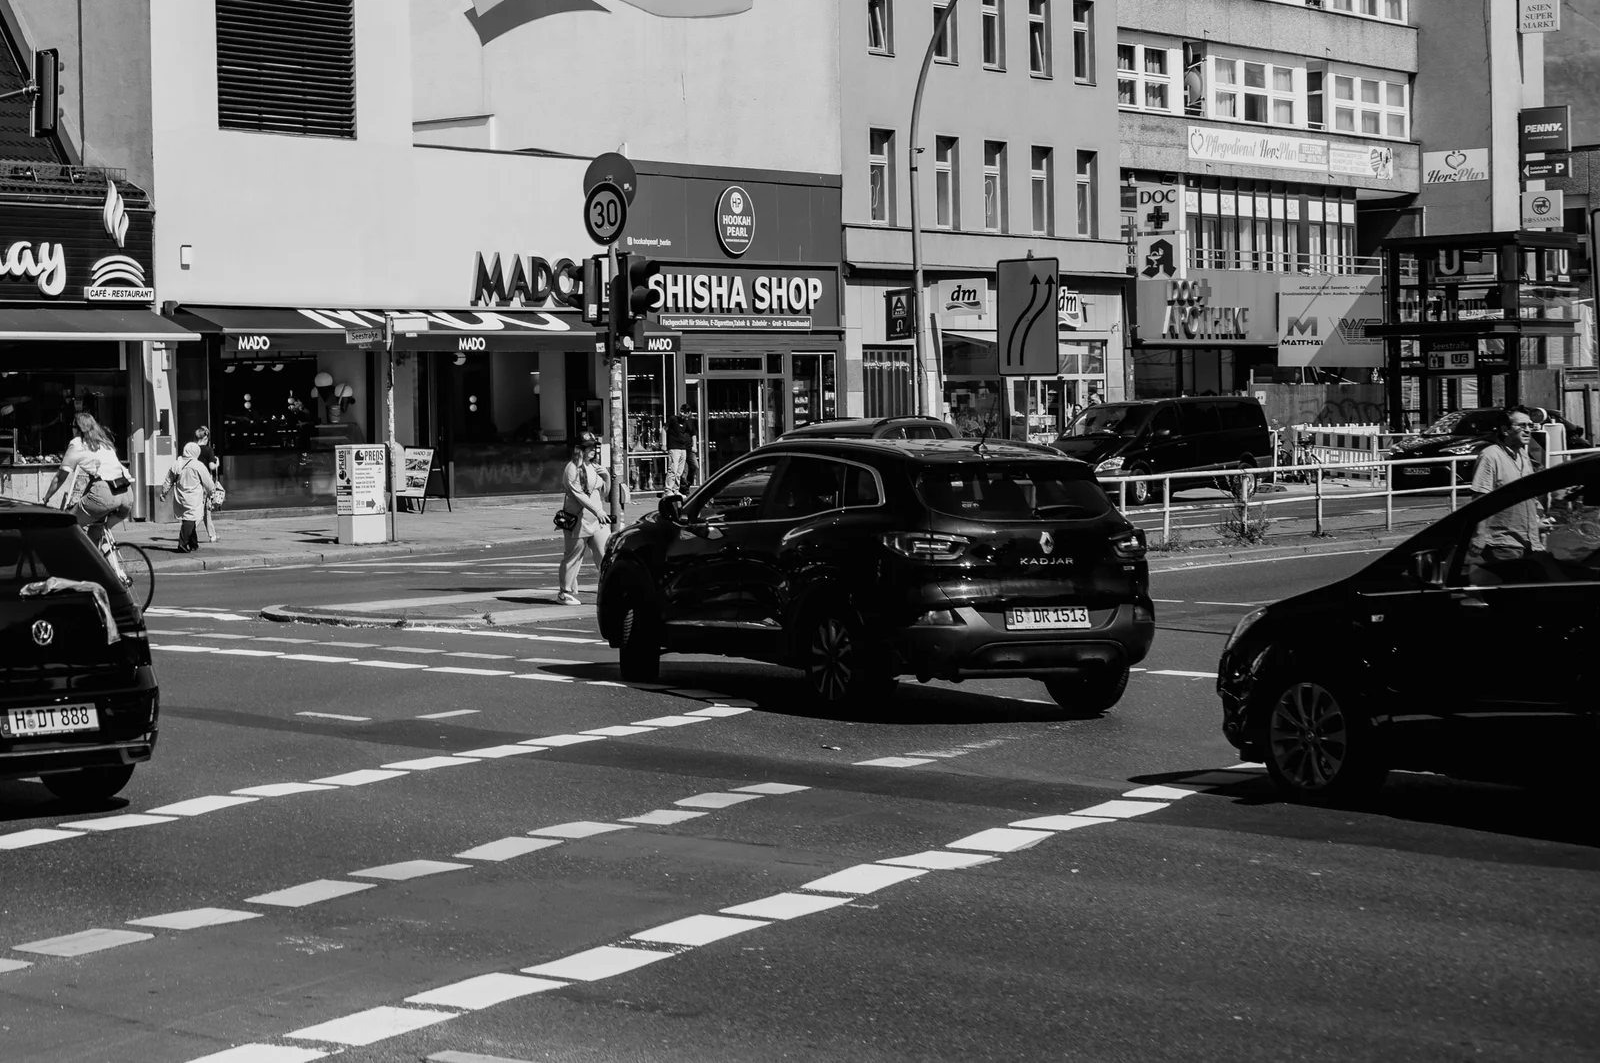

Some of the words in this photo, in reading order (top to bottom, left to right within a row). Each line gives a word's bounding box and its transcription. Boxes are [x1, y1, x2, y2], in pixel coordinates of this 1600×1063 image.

[1525, 3, 1552, 13] ASIEN
[1524, 11, 1553, 21] SUPER
[1522, 20, 1555, 30] MARKT
[1555, 163, 1564, 174] P
[1140, 189, 1176, 205] DOC
[593, 199, 618, 229] 30
[722, 215, 752, 226] HOOKAH
[726, 226, 748, 237] PEARL
[471, 251, 581, 306] MADO
[90, 288, 107, 298] CAFÉ
[111, 288, 153, 299] RESTAURANT
[648, 273, 748, 310] SHISHA
[755, 276, 822, 310] SHOP
[950, 285, 977, 302] dm
[1058, 288, 1077, 312] dm
[1162, 306, 1250, 339] APOTHEKE
[238, 336, 270, 350] MADO
[459, 337, 486, 350] MADO
[648, 338, 672, 350] MADO
[1432, 342, 1470, 350] Seestraße
[1452, 354, 1468, 363] U6
[1020, 557, 1074, 565] KADJAR
[1014, 609, 1024, 623] B
[1033, 609, 1050, 623] DR
[1054, 608, 1087, 622] 1513
[14, 711, 26, 729] H
[36, 708, 55, 728] DT
[61, 706, 90, 726] 888
